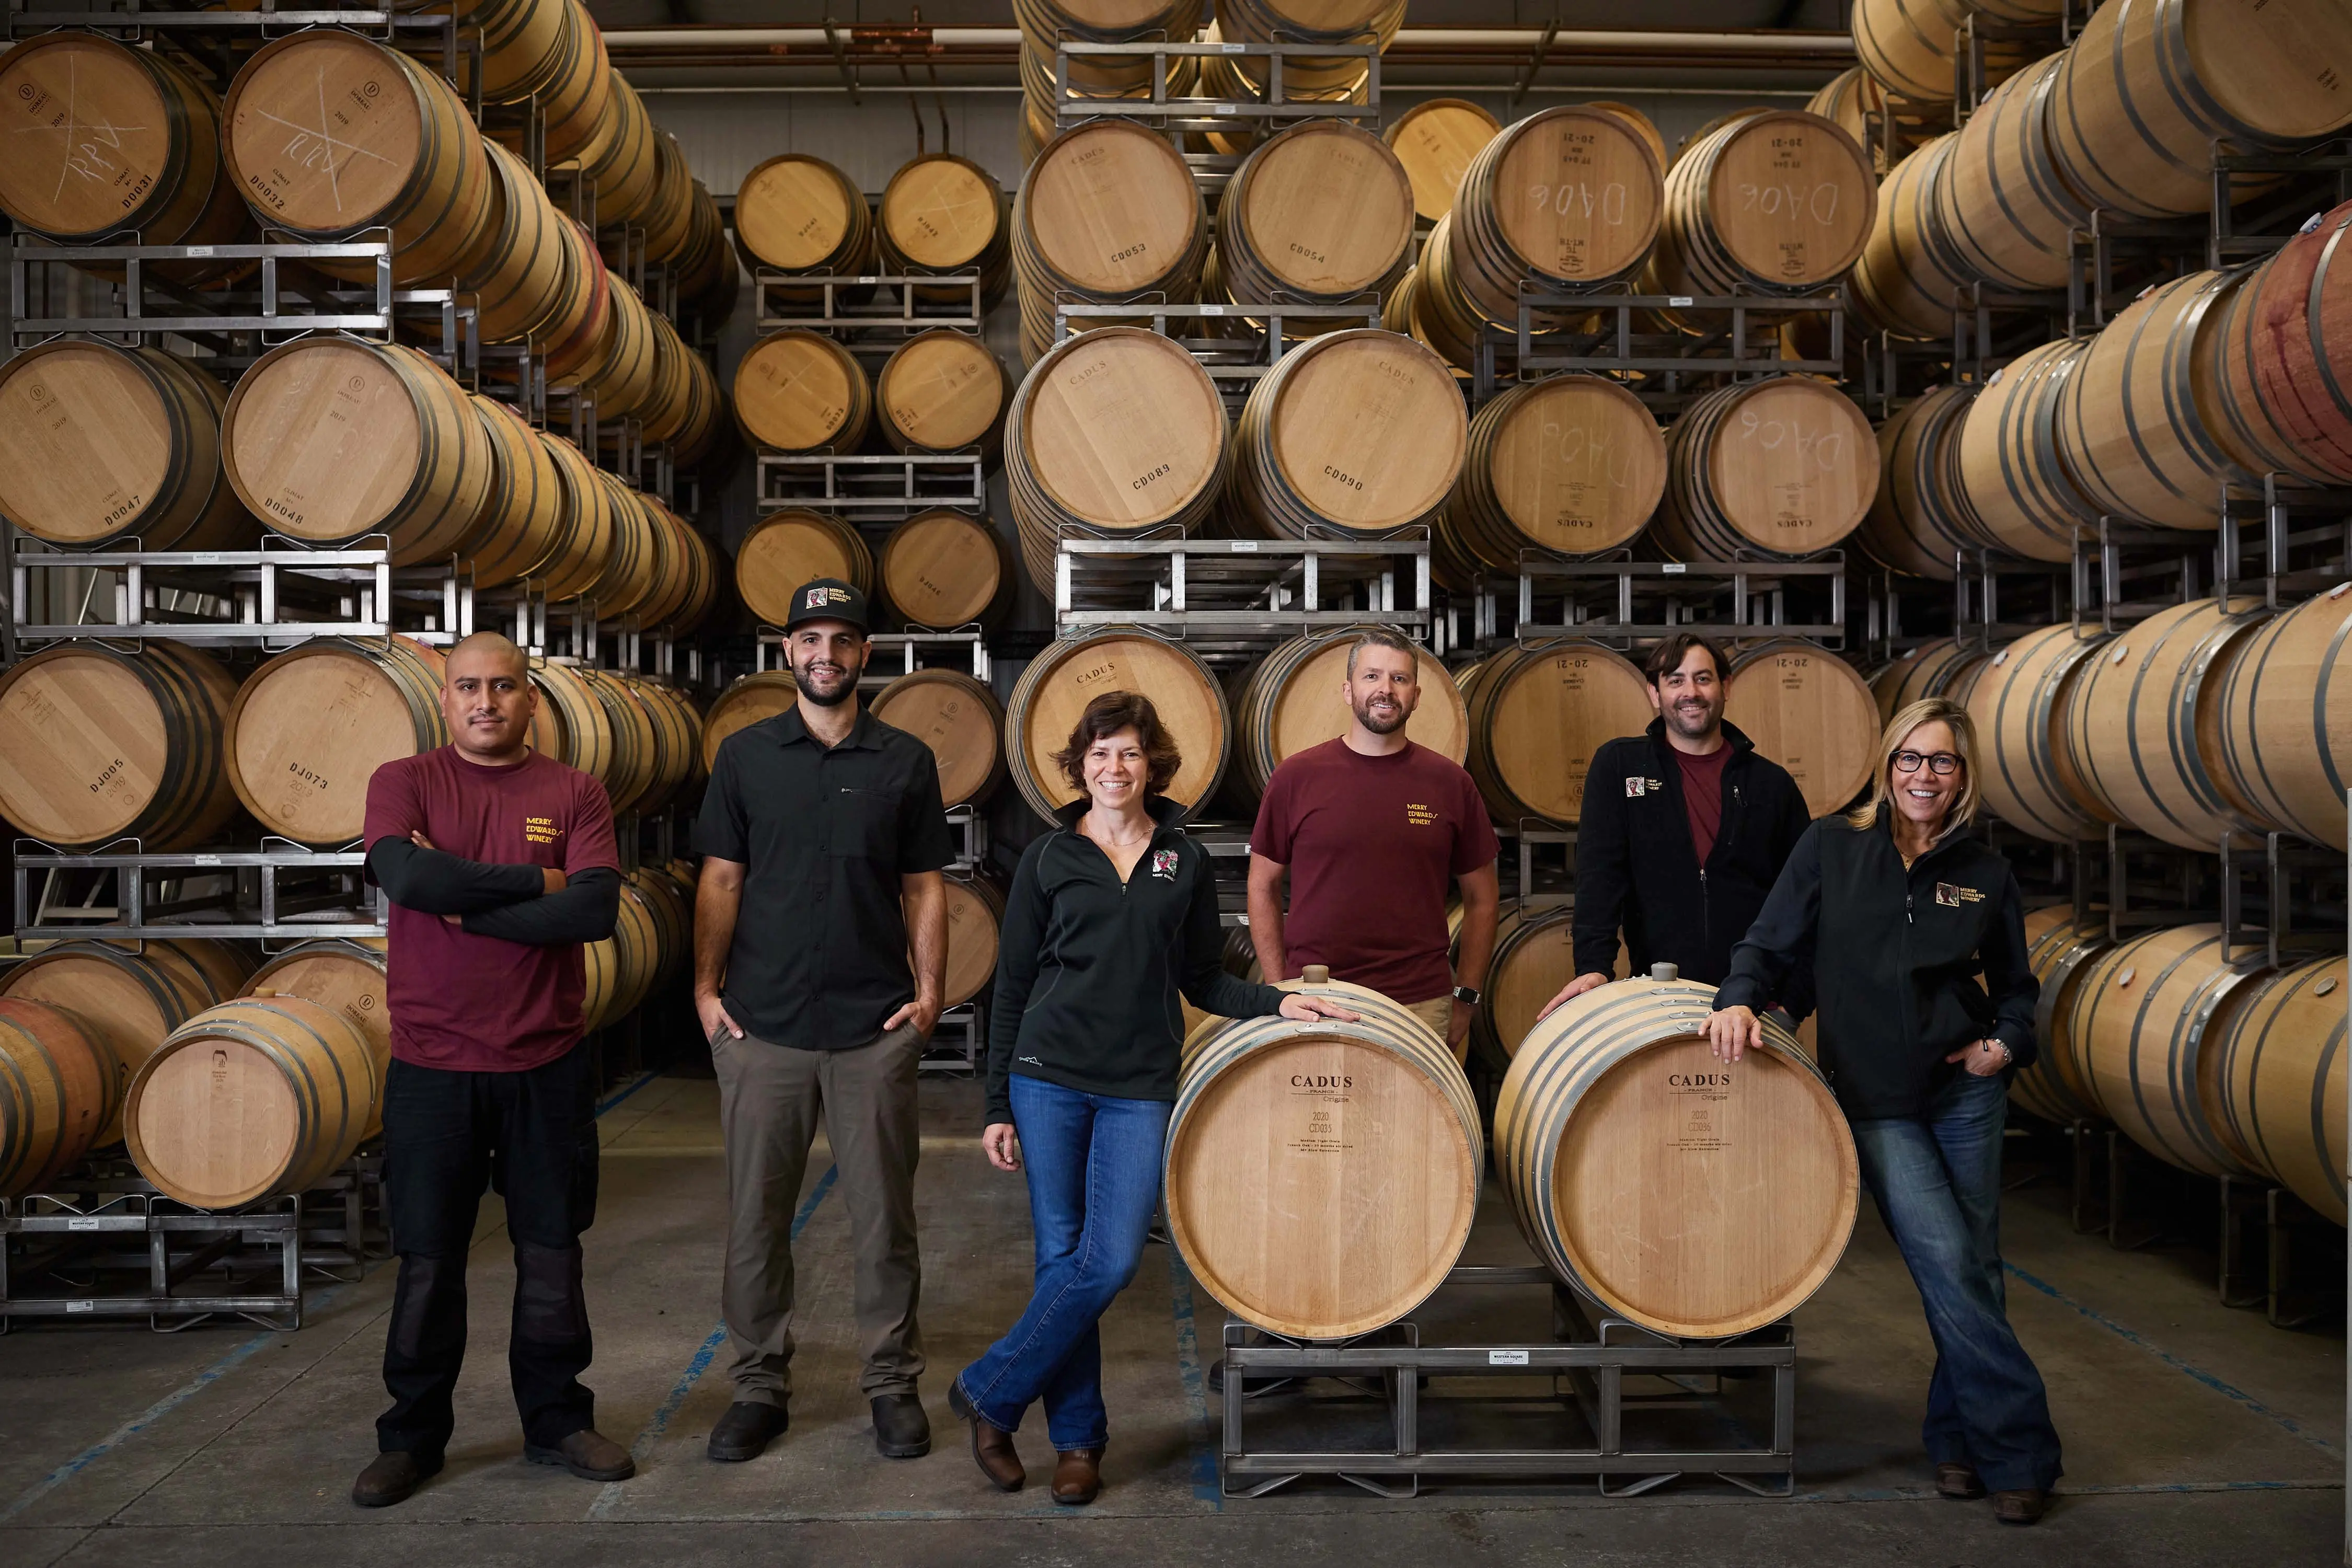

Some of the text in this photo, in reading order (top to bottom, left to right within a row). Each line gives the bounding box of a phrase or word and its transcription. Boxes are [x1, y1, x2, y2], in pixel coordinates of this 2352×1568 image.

[351, 90, 371, 110] DOREAU
[51, 112, 65, 127] 2019
[334, 111, 349, 125] 2019
[1071, 147, 1104, 164] CADUS
[114, 168, 130, 186] CLIMAT
[273, 168, 290, 186] CLIMAT
[1111, 243, 1146, 262] CD053
[1290, 243, 1325, 263] CD054
[1070, 360, 1106, 385] CADUS
[1379, 361, 1415, 385] CADUS
[52, 417, 66, 430] 2019
[1133, 464, 1170, 490] CD089
[1324, 465, 1363, 491] CD090
[1557, 518, 1593, 528] CADUS
[829, 592, 851, 601] EDWARDS
[1077, 662, 1115, 683] CADUS
[90, 759, 123, 792] DJ005
[290, 762, 328, 789] DJ073
[106, 776, 125, 798] 2019
[289, 779, 313, 797] 2019
[526, 825, 563, 836] EDWARDS
[526, 834, 553, 844] WINERY
[1291, 1075, 1352, 1088] CADUS
[1669, 1074, 1730, 1086] CADUS
[1312, 1112, 1329, 1121] 2020
[1691, 1110, 1708, 1120] 2020
